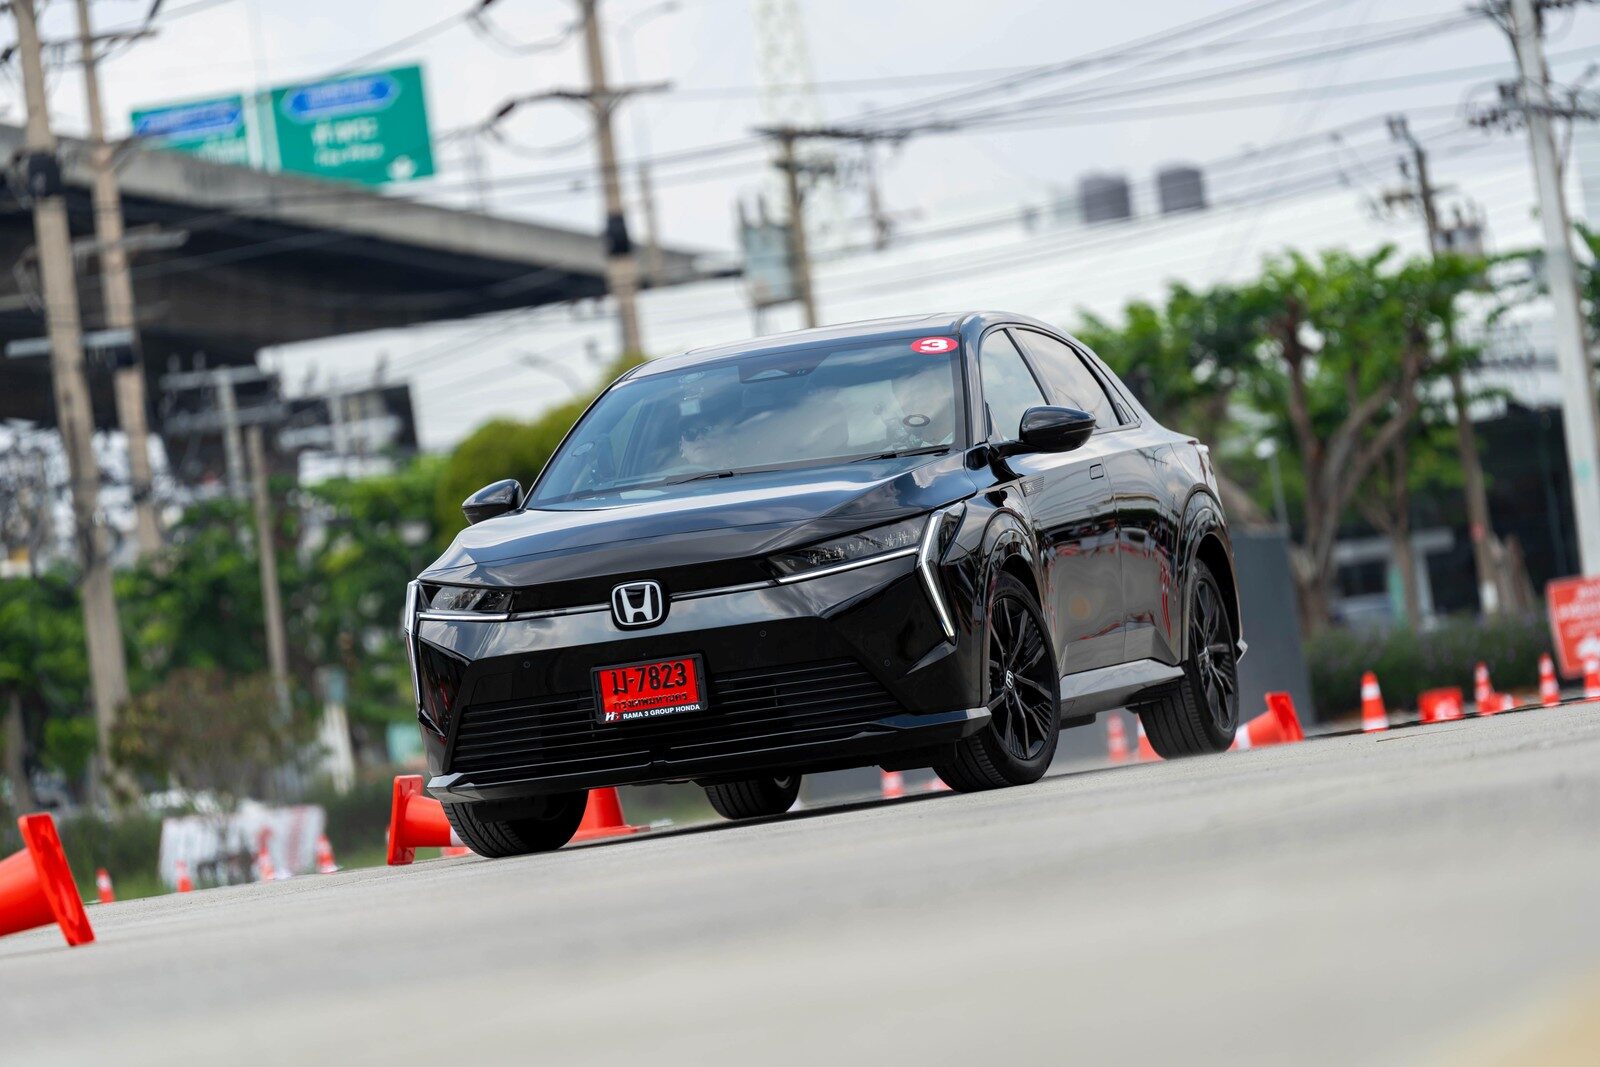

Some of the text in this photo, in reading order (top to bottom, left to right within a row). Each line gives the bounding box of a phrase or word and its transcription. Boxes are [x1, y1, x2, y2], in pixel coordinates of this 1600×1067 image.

[919, 339, 949, 352] 3
[622, 711, 644, 720] RAMA
[644, 710, 650, 718] 3
[649, 707, 675, 717] GROUP
[675, 703, 701, 713] HONDA
